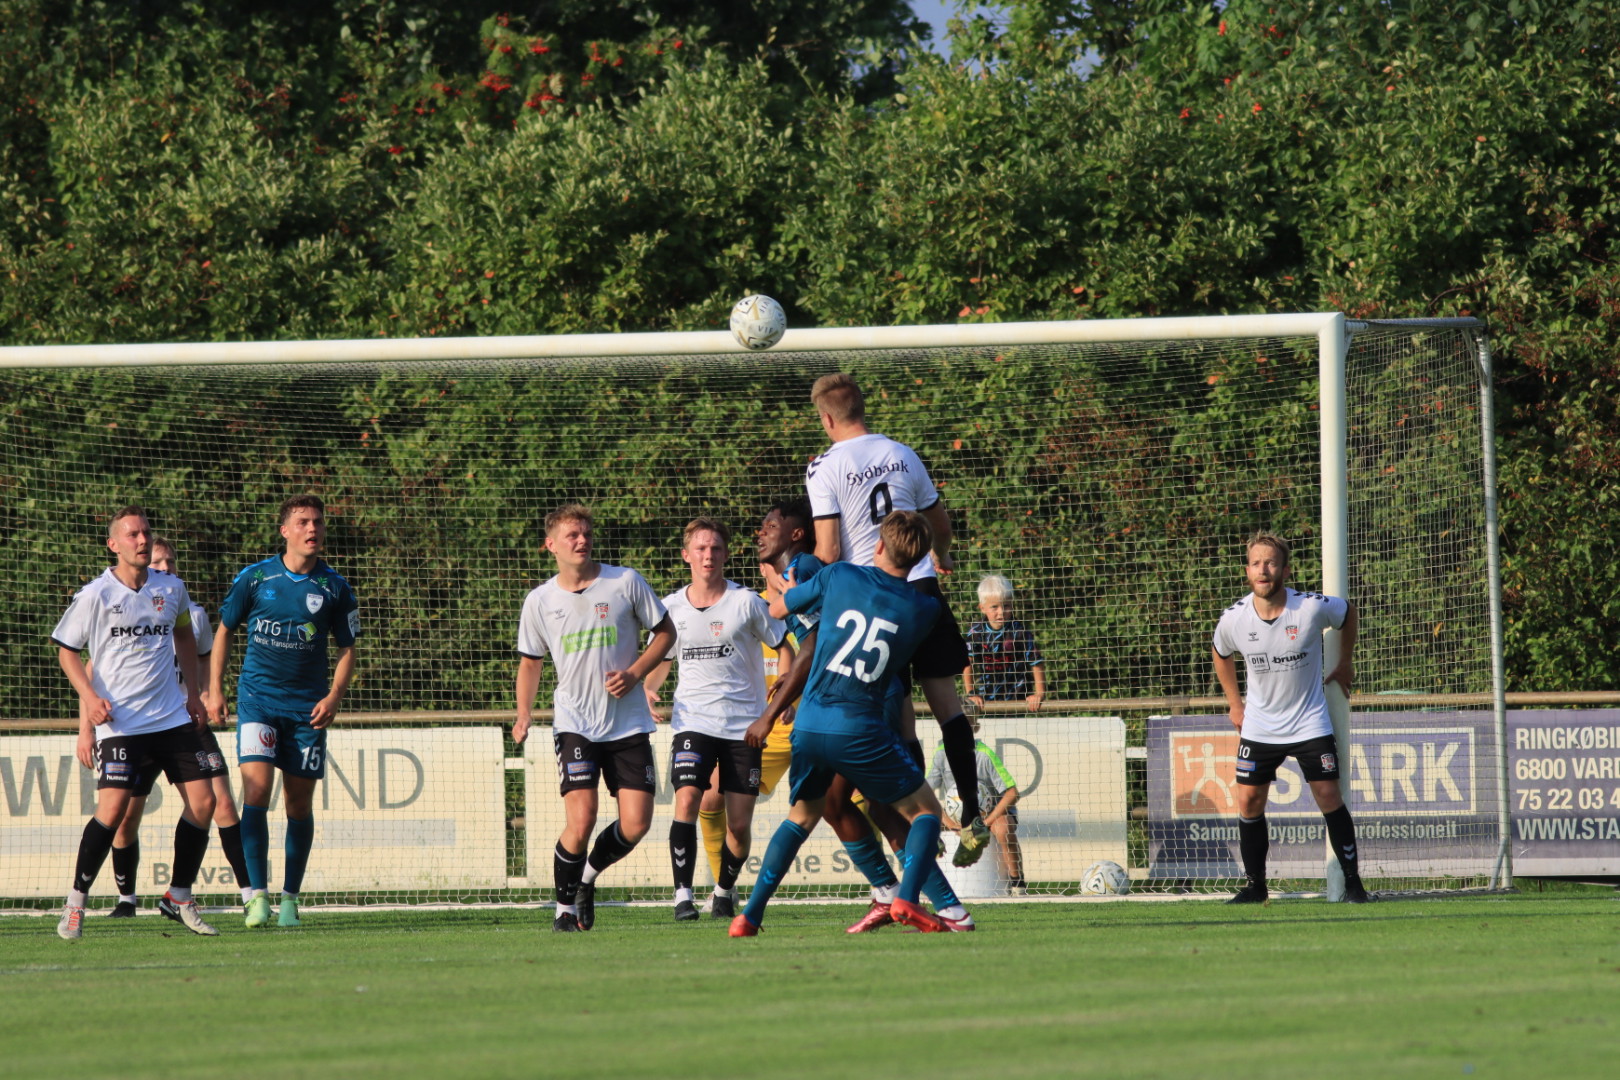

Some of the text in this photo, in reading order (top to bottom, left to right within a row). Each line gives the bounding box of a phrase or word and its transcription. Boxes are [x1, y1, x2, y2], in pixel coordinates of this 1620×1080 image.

[758, 325, 773, 334] VIF
[846, 460, 909, 486] Sydbank
[110, 624, 169, 637] EMCARE
[254, 617, 281, 636] NTG
[271, 638, 298, 649] Transport
[826, 609, 899, 683] 25
[1251, 656, 1265, 665] DIN
[1272, 651, 1308, 664] bruun
[683, 739, 691, 750] 6
[1239, 744, 1251, 758] 10
[112, 747, 127, 760] 16
[301, 746, 321, 771] 15
[574, 747, 582, 759] 8
[1267, 742, 1464, 805] SARK
[1515, 758, 1567, 780] 6800
[1516, 789, 1542, 810] 75
[1547, 788, 1573, 810] 22
[1578, 788, 1604, 810] 03
[1189, 822, 1241, 841] Samm
[1267, 821, 1325, 844] bygger
[1516, 817, 1620, 841] WWW.STA
